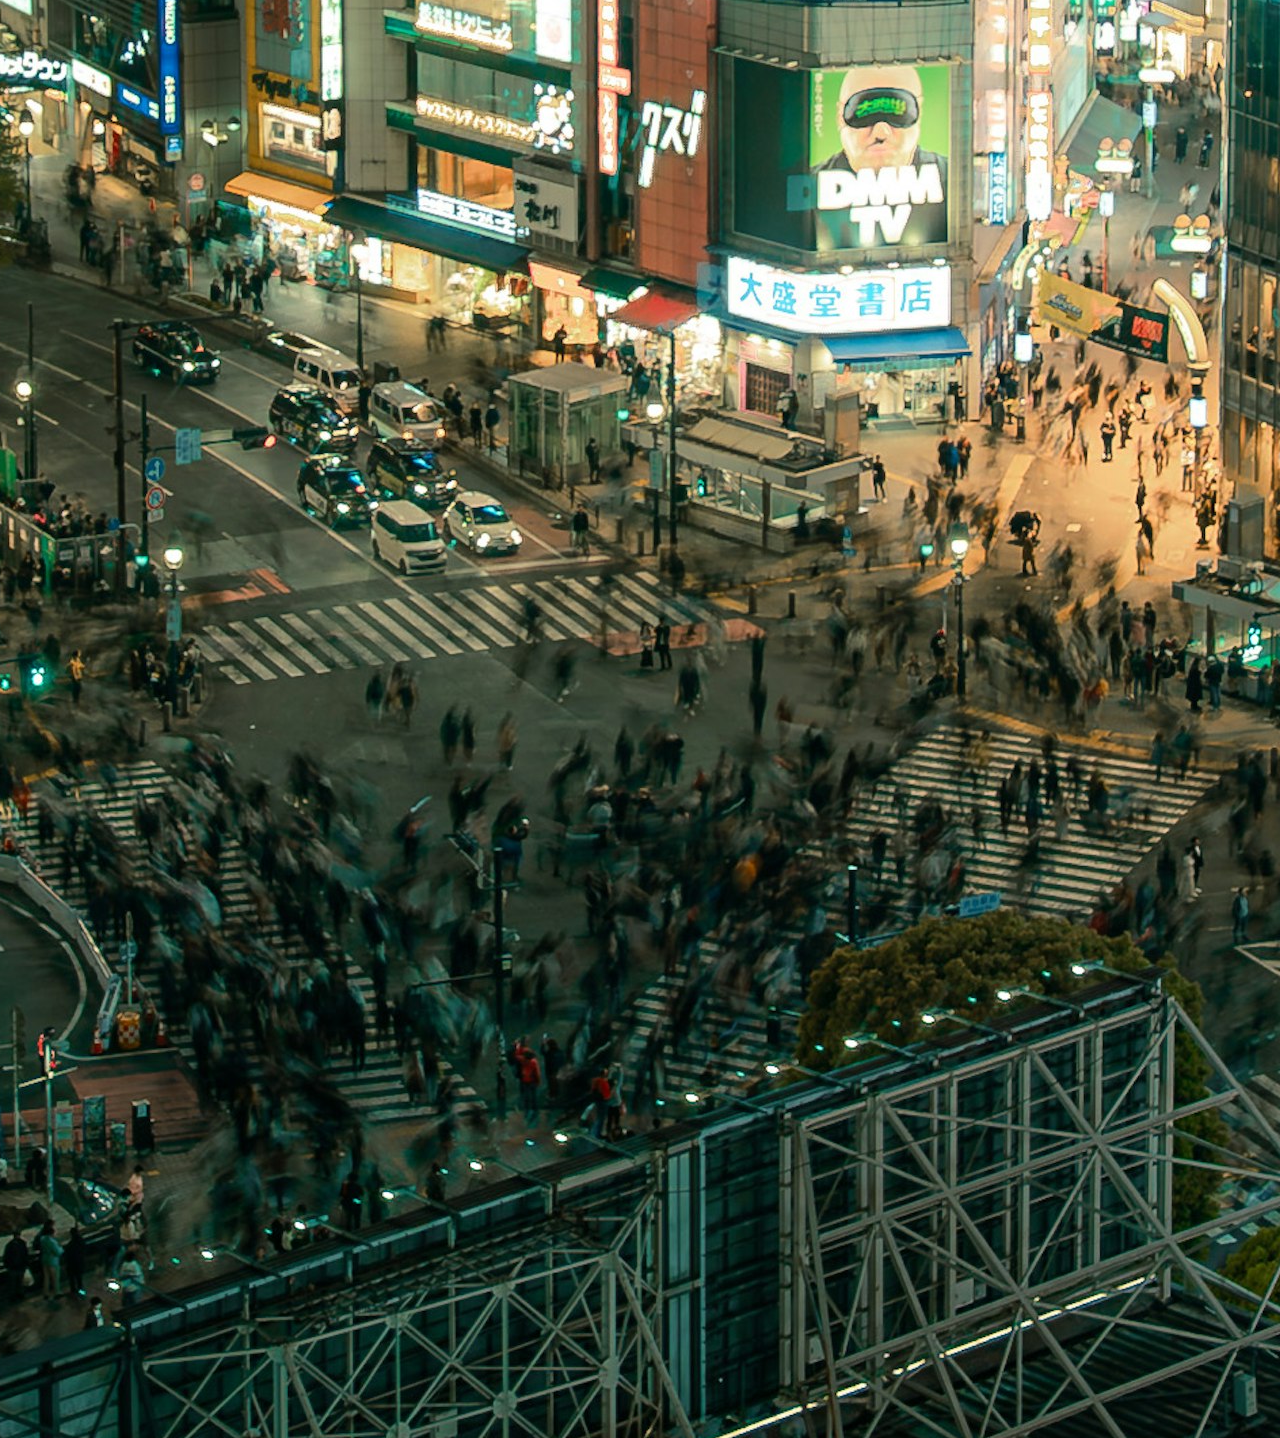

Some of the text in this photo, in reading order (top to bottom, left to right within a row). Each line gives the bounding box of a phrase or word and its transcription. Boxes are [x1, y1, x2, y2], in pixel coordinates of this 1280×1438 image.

[816, 162, 945, 211] DMM
[849, 204, 912, 246] TV
[738, 271, 933, 320] 大盛堂書店
